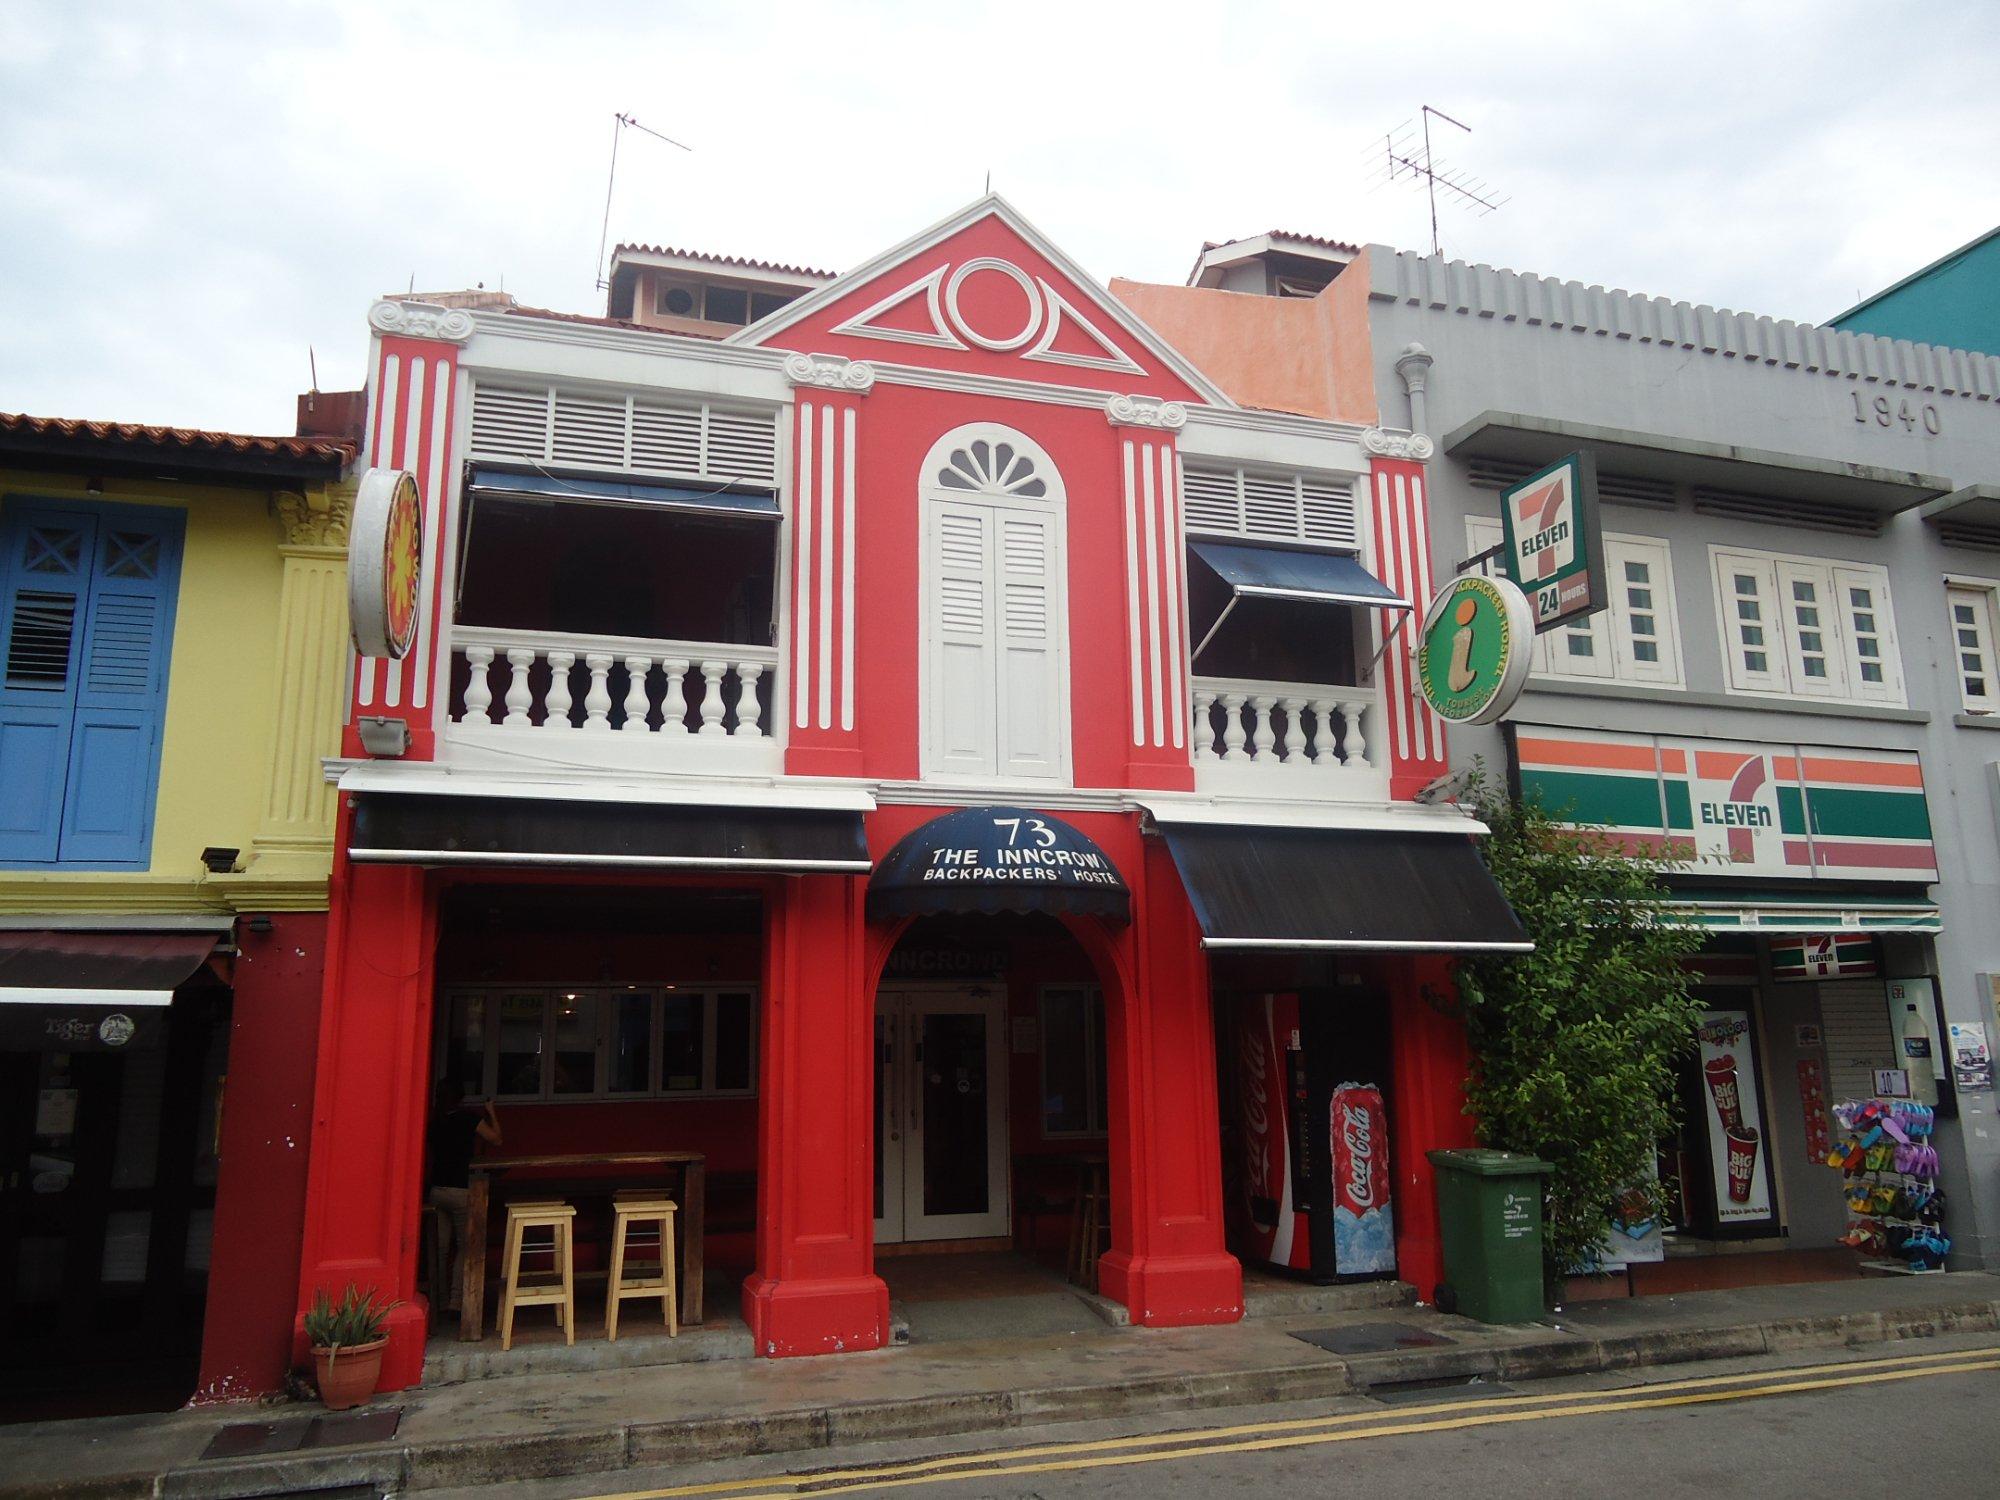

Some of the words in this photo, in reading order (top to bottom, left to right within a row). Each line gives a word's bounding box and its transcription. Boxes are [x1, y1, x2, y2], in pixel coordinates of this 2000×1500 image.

[1851, 391, 1939, 435] 1940
[1519, 479, 1564, 580] 7
[1539, 588, 1558, 616] 24
[1561, 583, 1587, 603] HOURS
[1423, 675, 1436, 701] THE
[1456, 579, 1506, 618] ACKPACKERS
[1494, 620, 1508, 676] HOSTEL
[1694, 754, 1766, 864] 7
[993, 818, 1056, 847] 73
[932, 848, 979, 865] THE
[998, 848, 1108, 870] INNCROW
[923, 867, 1062, 880] BACKPACKERS'
[1073, 869, 1119, 885] HOSTE
[1806, 935, 1831, 975] 7
[45, 1017, 94, 1040] Tiger
[1716, 1096, 1737, 1111] GUL
[1729, 1161, 1752, 1180] GUL
